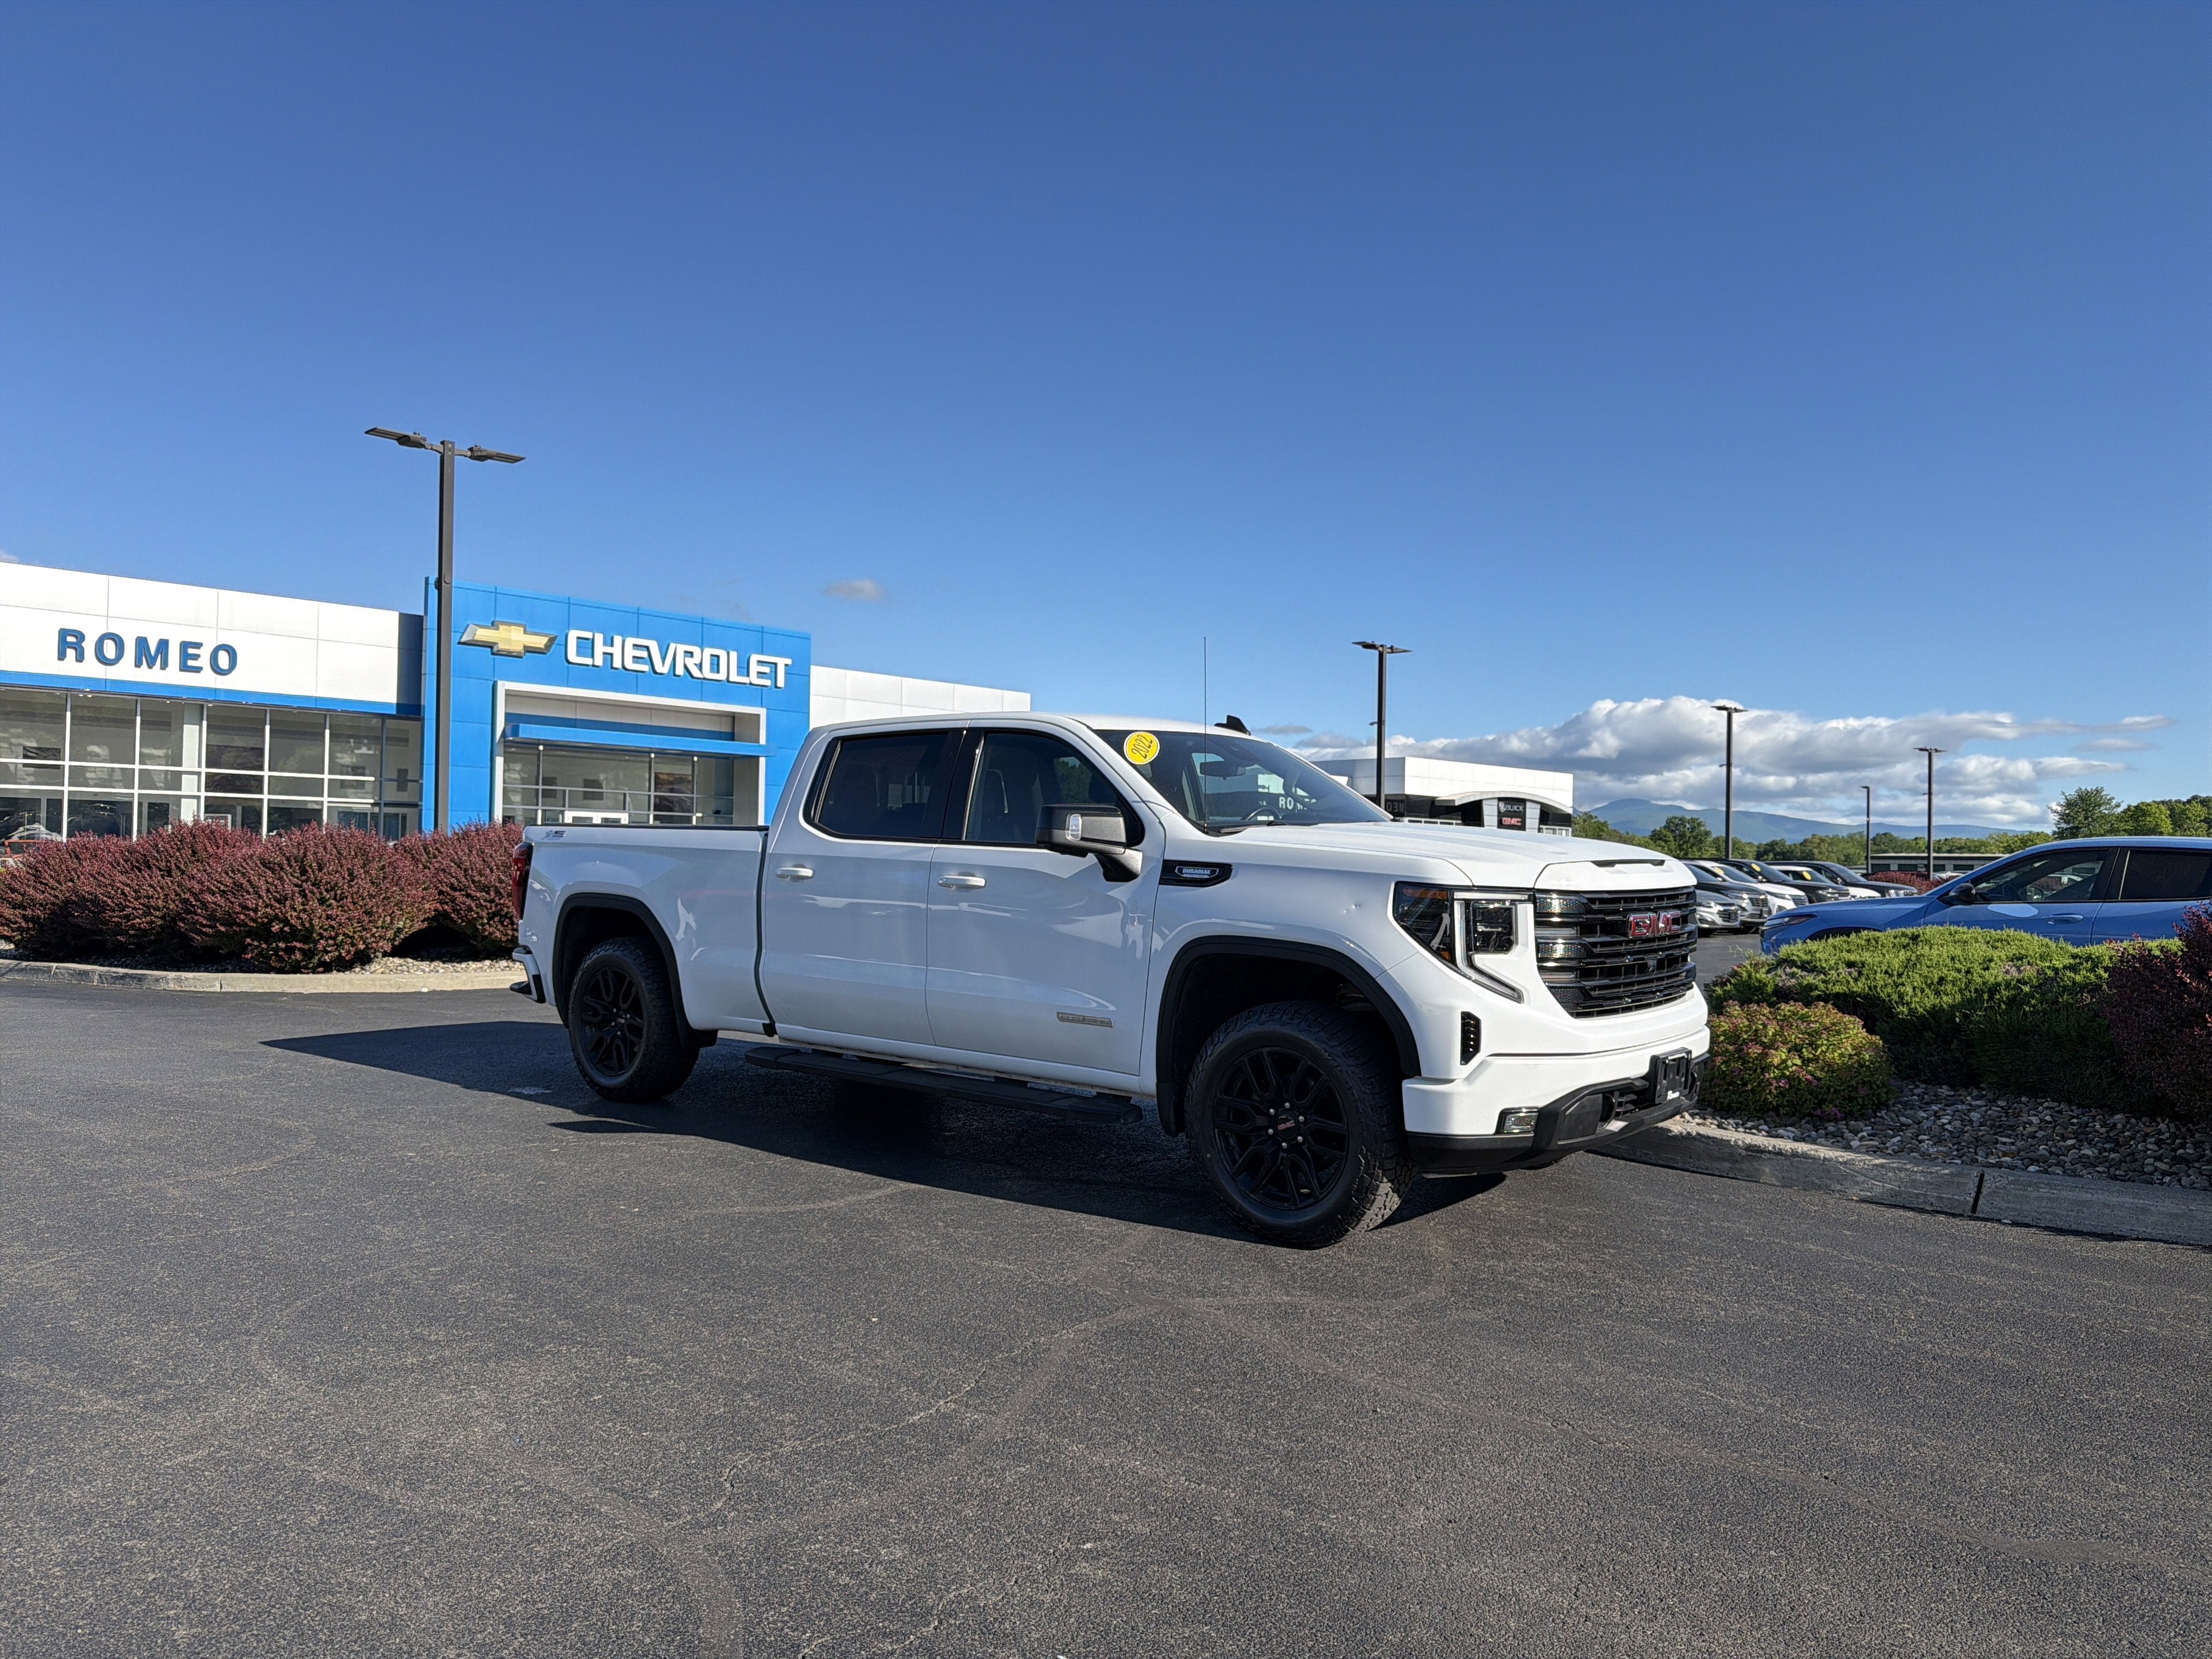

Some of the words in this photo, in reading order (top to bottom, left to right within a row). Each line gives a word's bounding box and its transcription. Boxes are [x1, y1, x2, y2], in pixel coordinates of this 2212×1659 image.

[57, 628, 238, 676] ROMEO
[565, 629, 793, 689] CHEVROLET
[1131, 734, 1153, 760] 2022
[1502, 817, 1522, 826] GMC
[1627, 910, 1681, 939] GMC
